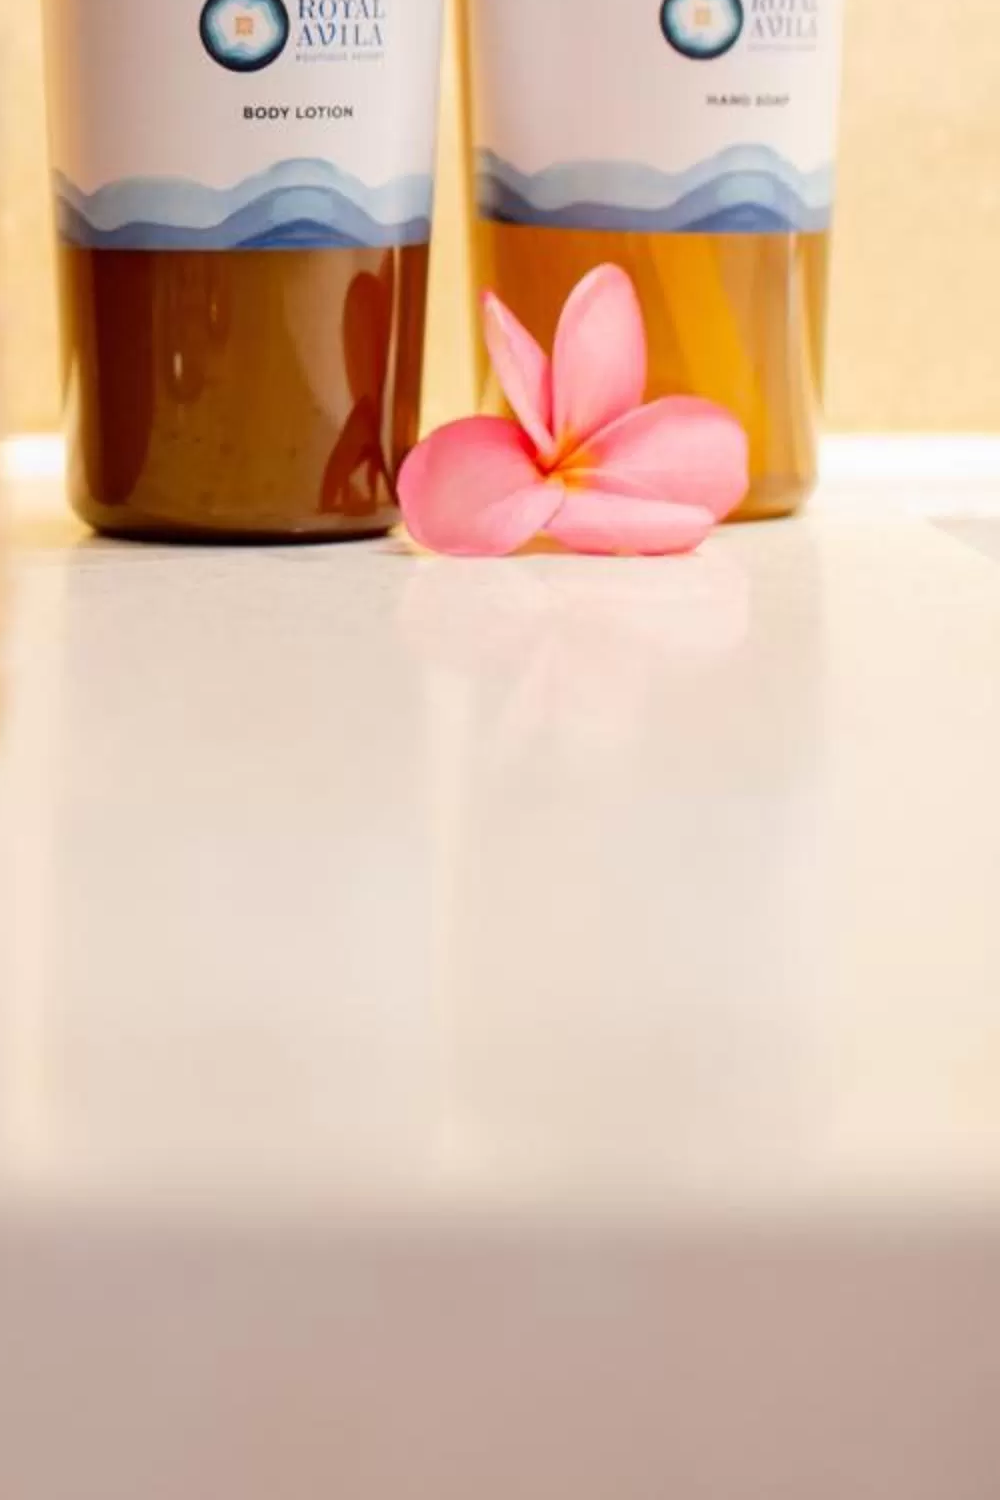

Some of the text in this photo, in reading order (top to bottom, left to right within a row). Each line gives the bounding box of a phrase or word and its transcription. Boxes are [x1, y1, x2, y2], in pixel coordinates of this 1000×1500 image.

[296, 22, 384, 46] AVILA
[243, 104, 353, 119] BODY LOTION
